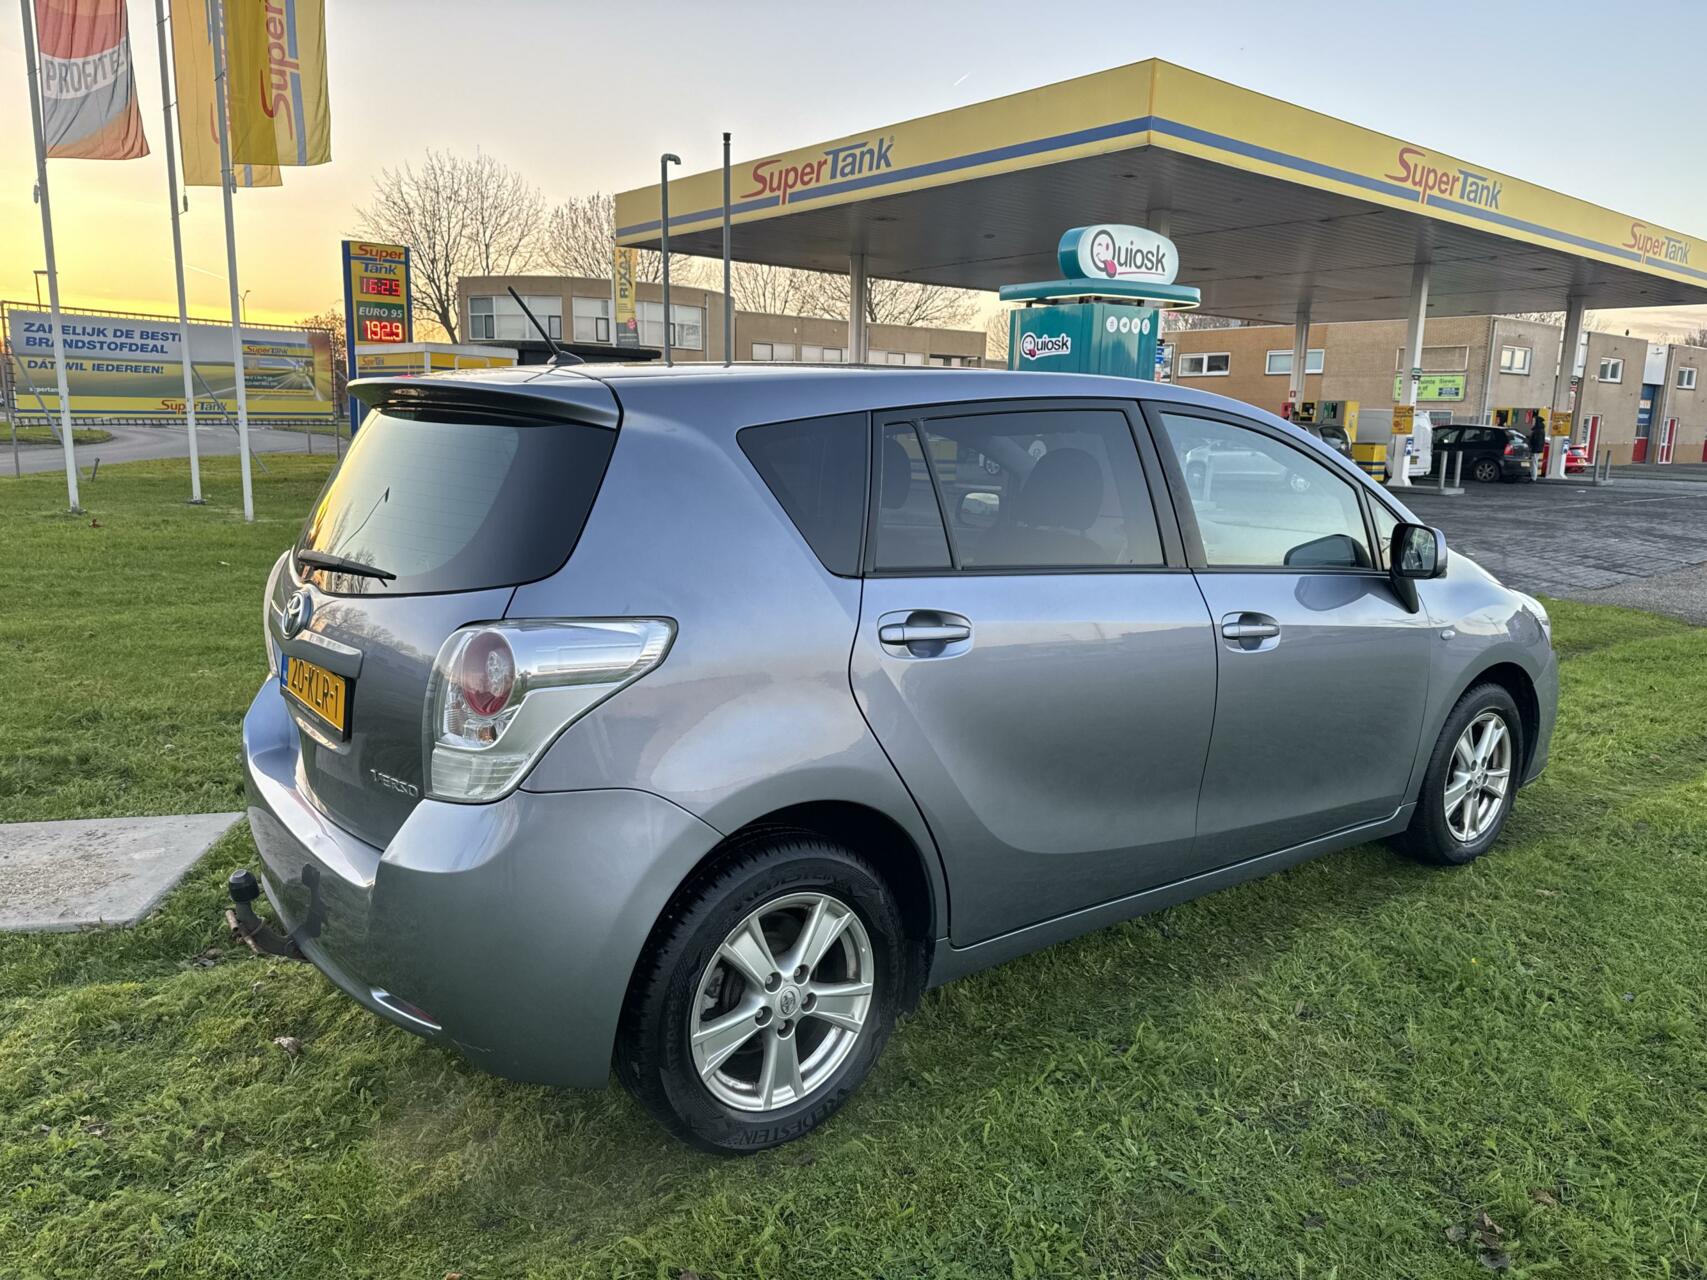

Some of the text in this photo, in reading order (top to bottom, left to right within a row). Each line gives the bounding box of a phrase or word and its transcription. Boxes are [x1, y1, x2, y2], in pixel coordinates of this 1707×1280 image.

[44, 41, 128, 94] PROFITE
[740, 137, 894, 206] SuperTank
[1384, 147, 1502, 210] SuperTank
[352, 244, 404, 262] Super
[1090, 229, 1166, 278] Quiosk
[1622, 222, 1690, 265] SuperTank
[360, 262, 397, 275] Tank
[359, 307, 403, 318] EURO 95
[23, 322, 182, 343] ZAELIJK DE BEST
[1022, 334, 1069, 358] Quiosk
[92, 363, 164, 374] IEDEREEN!
[155, 400, 227, 415] SuprTank
[291, 658, 340, 719] 20-KLR-1
[370, 769, 419, 798] VERSO
